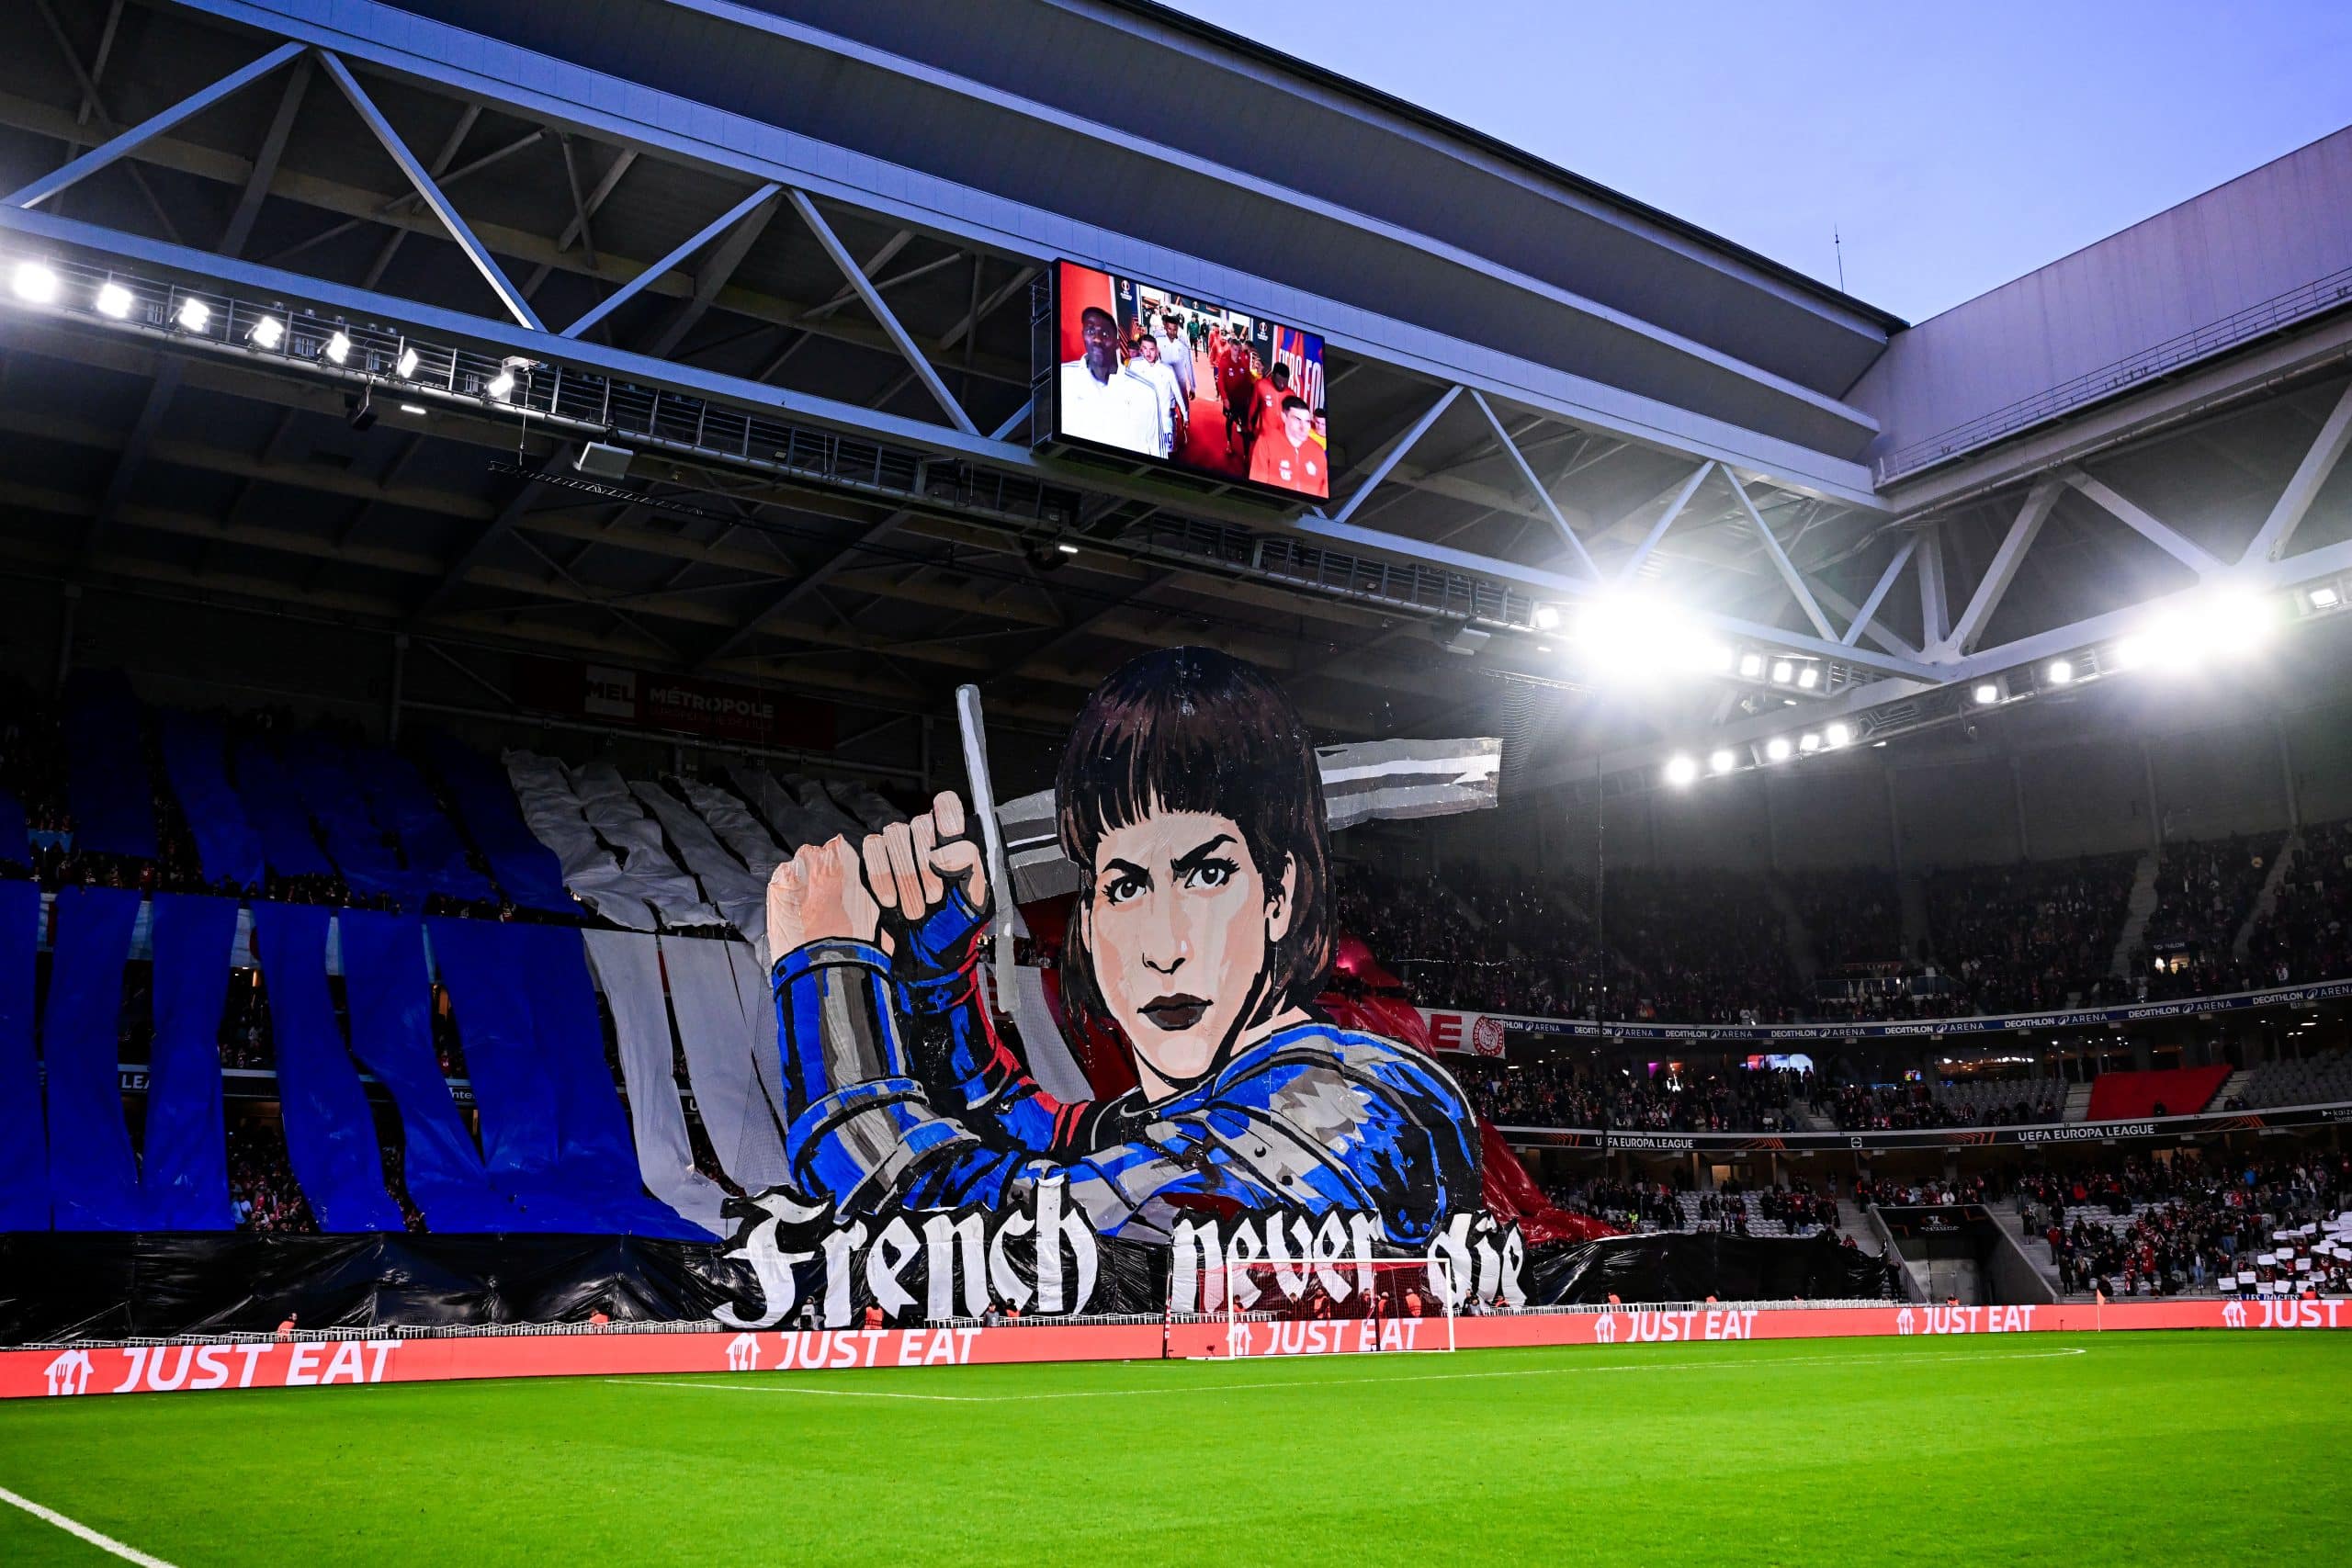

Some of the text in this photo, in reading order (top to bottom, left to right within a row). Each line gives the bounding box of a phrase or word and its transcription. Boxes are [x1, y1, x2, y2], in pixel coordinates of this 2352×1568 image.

[650, 685, 774, 719] MÉTROPOLE
[2253, 991, 2303, 1005] DECATHLON
[2321, 985, 2352, 997] AREN
[2128, 999, 2233, 1019] DECATHLON ARENA
[1534, 1023, 1560, 1032] ARENA
[1884, 1021, 1984, 1035] DECATHLON ARENA
[2004, 1013, 2108, 1028] DECATHLON ARENA
[1574, 1025, 1654, 1037] DECATHON ARENA
[1665, 1029, 1753, 1039] DECATHLON ARENA
[1770, 1028, 1867, 1038] DECATHLON ARENA
[1595, 1136, 1694, 1149] UFA EUROPA LEAGUE
[2018, 1123, 2155, 1142] UEFA EUROPA LEAGUE
[711, 1175, 1528, 1329] French never die
[1922, 1305, 2036, 1335] JUST EAT
[2258, 1300, 2345, 1327] JUST
[1608, 1309, 1758, 1343] JUST EAT
[1264, 1318, 1424, 1355] JUST EAT
[775, 1327, 983, 1370] JUST EAT
[113, 1338, 403, 1393] JUST EAT
